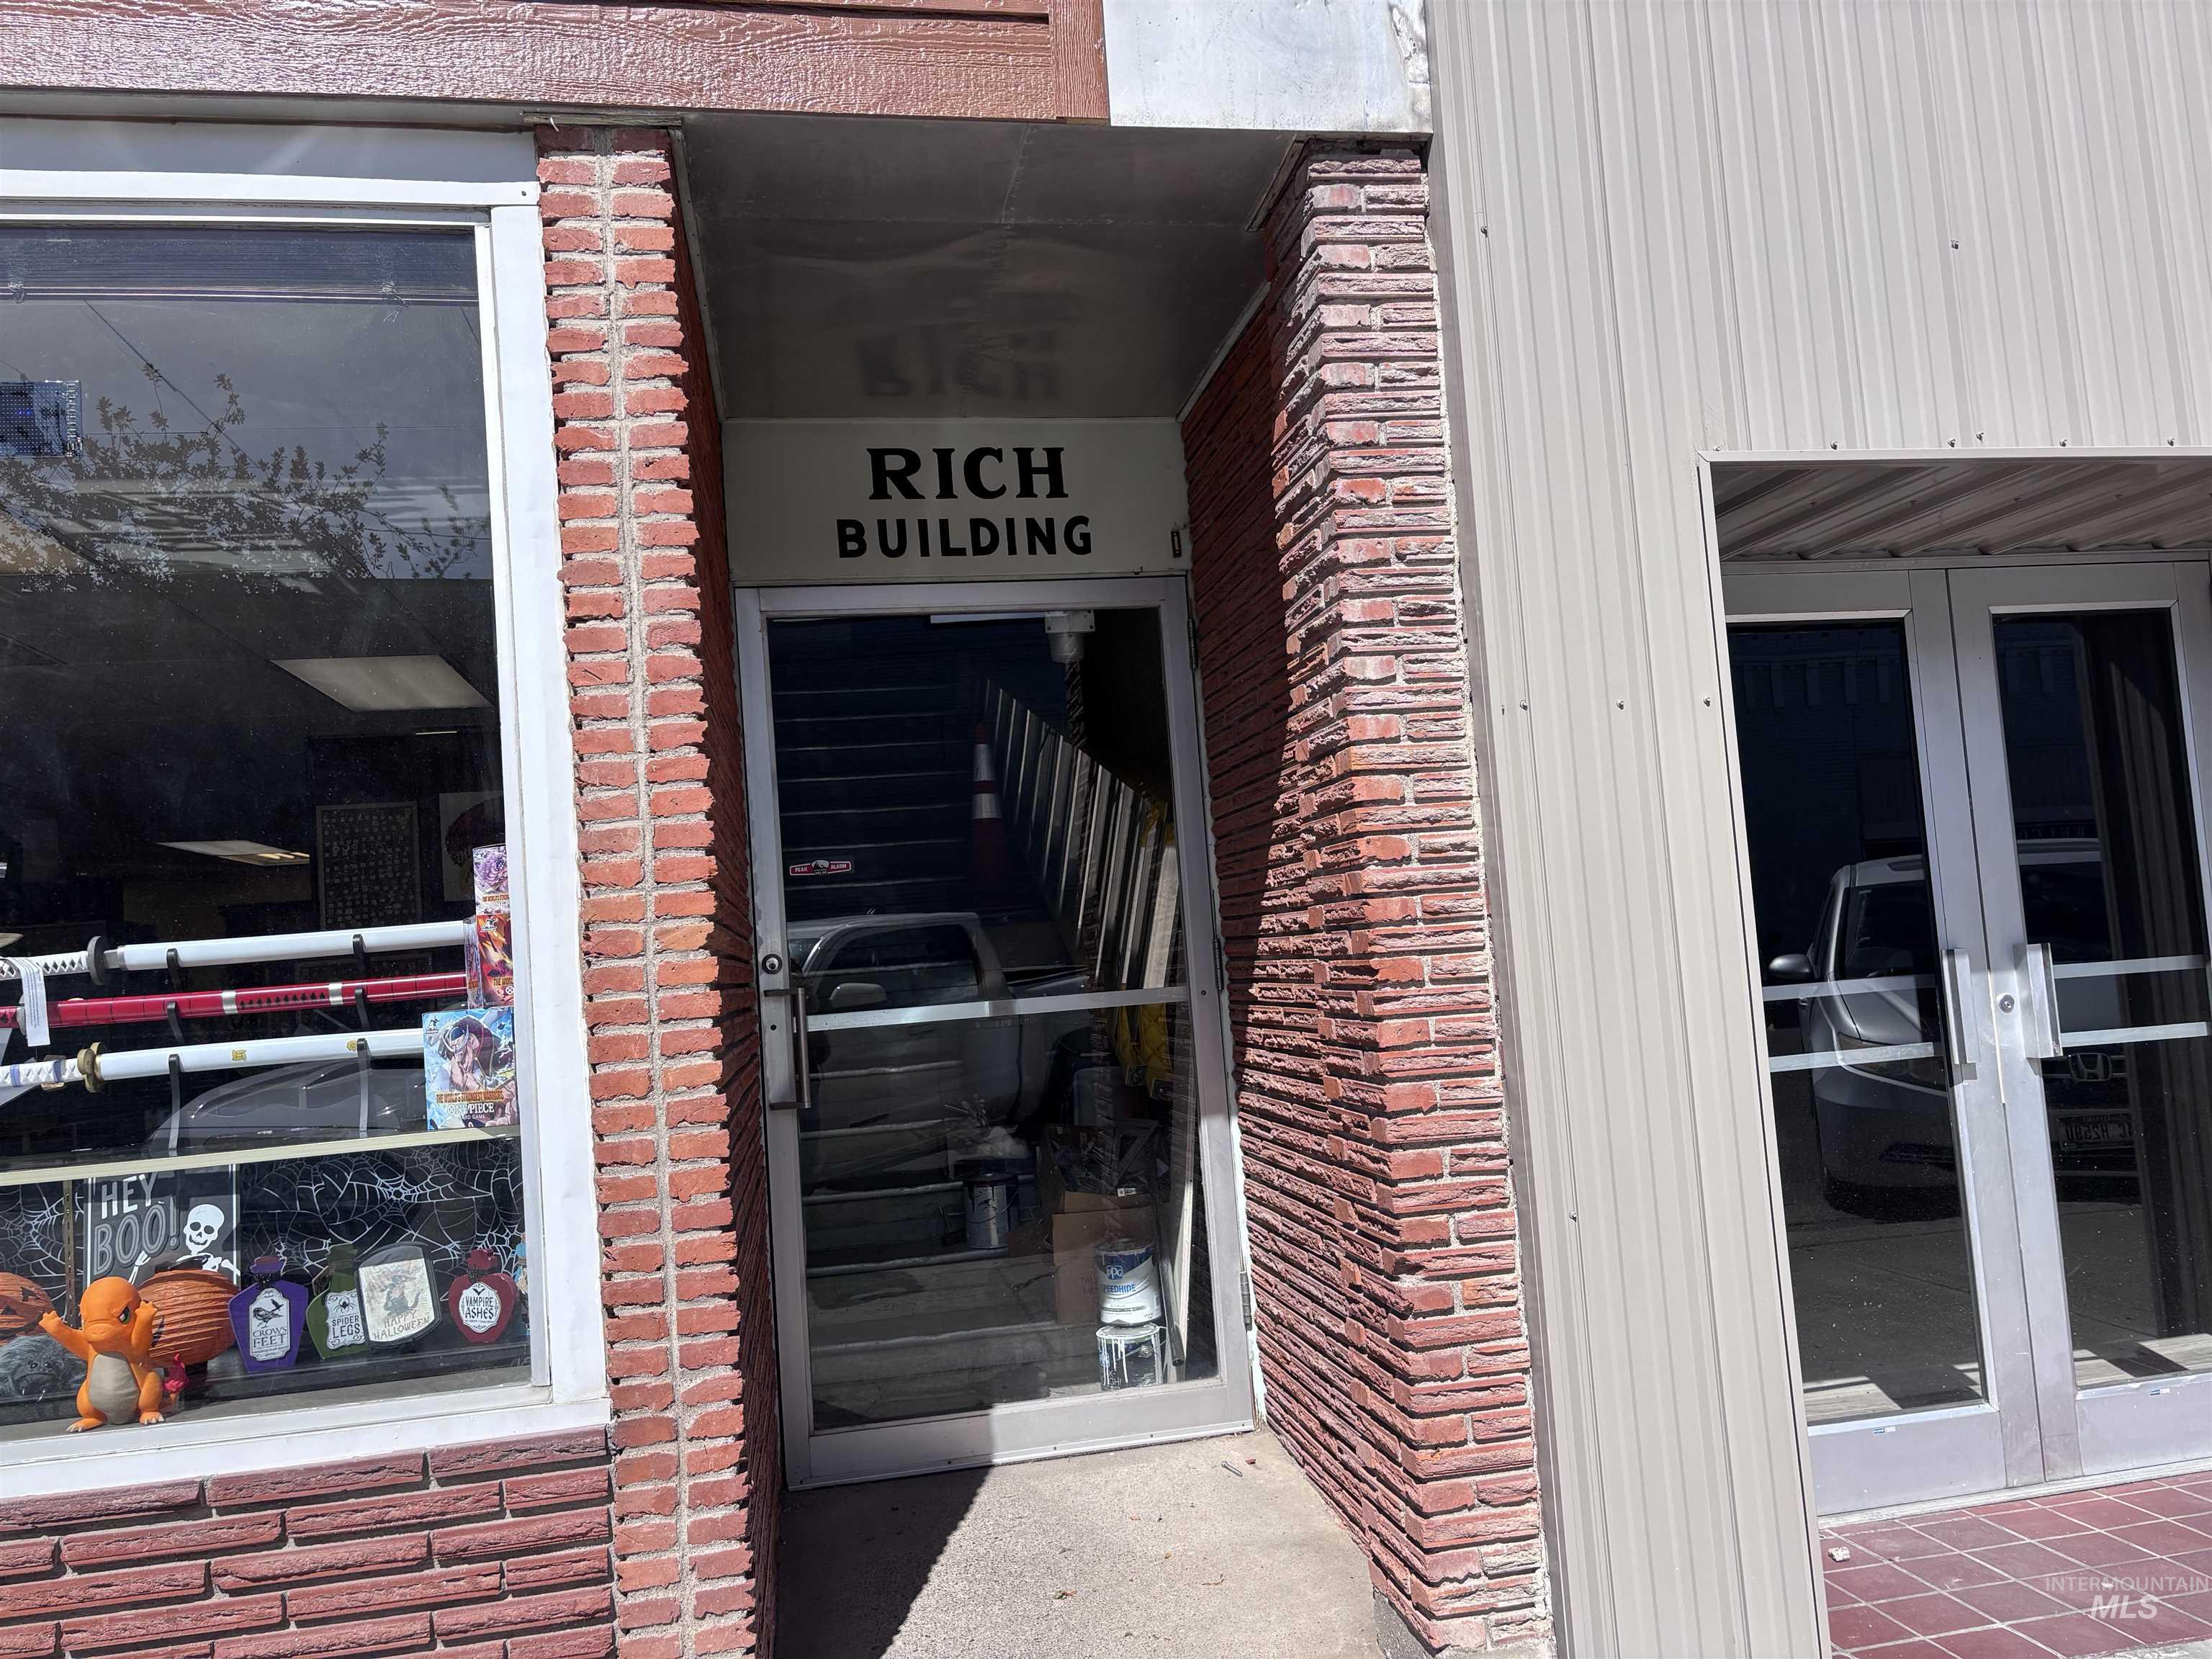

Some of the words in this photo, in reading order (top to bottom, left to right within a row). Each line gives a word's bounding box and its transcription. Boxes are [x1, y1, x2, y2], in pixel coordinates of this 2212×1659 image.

[866, 446, 1069, 500] RICH
[837, 516, 1092, 559] BUILDING
[469, 1102, 495, 1115] PIECE
[102, 1172, 158, 1219] HEY
[94, 1195, 178, 1275] BOO!
[1107, 1267, 1123, 1279] PPG
[465, 1295, 494, 1308] VAMPIRE
[331, 1315, 359, 1326] SPIDER
[384, 1309, 417, 1328] HAPPY
[465, 1307, 494, 1320] ASHES
[332, 1323, 360, 1339] LEGS
[373, 1316, 431, 1341] HALLOWEEN
[253, 1333, 287, 1348] FEET
